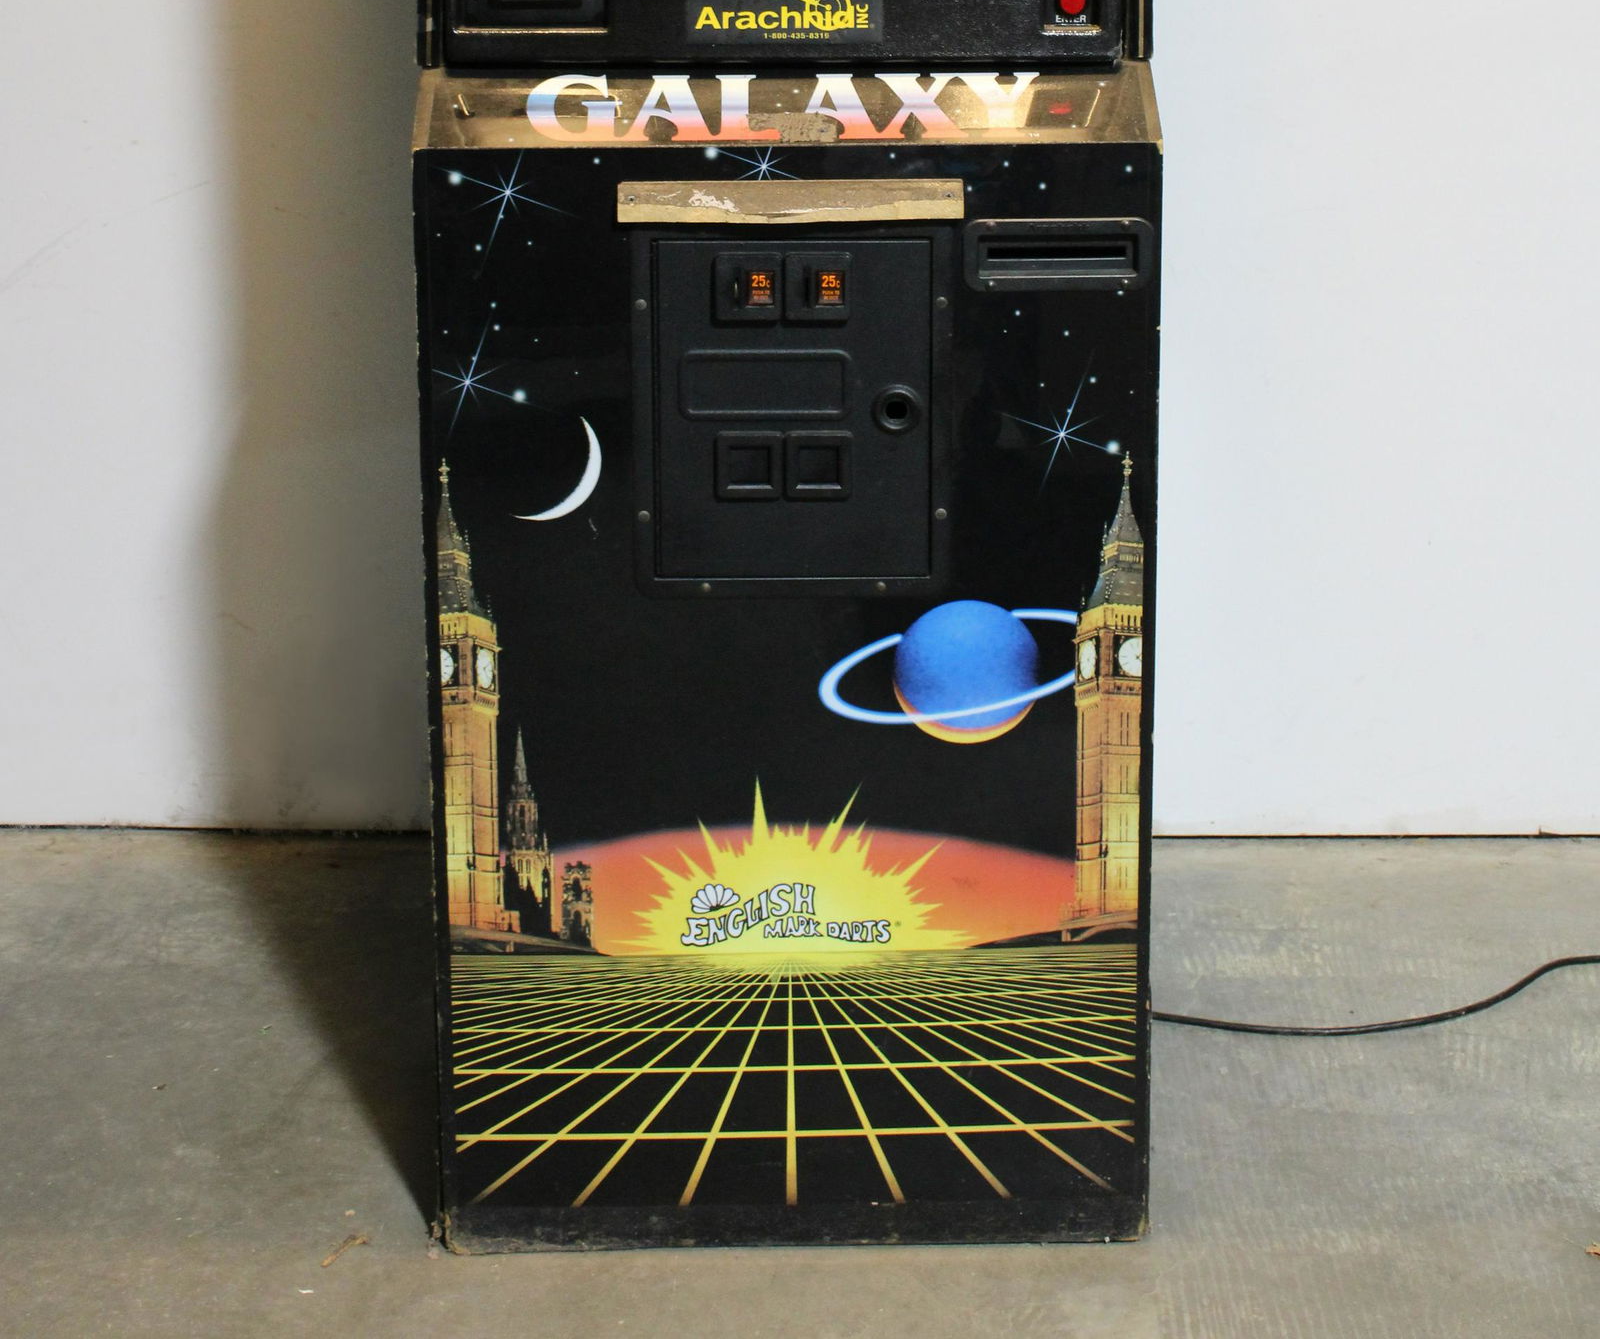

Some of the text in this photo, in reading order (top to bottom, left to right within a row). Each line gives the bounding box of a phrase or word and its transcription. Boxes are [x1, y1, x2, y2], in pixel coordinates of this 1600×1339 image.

[695, 6, 854, 30] Arachnid
[856, 3, 869, 29] INC
[526, 73, 1040, 141] GALAXY
[681, 883, 815, 947] ENGLISH
[763, 916, 892, 943] MARK DARTS
